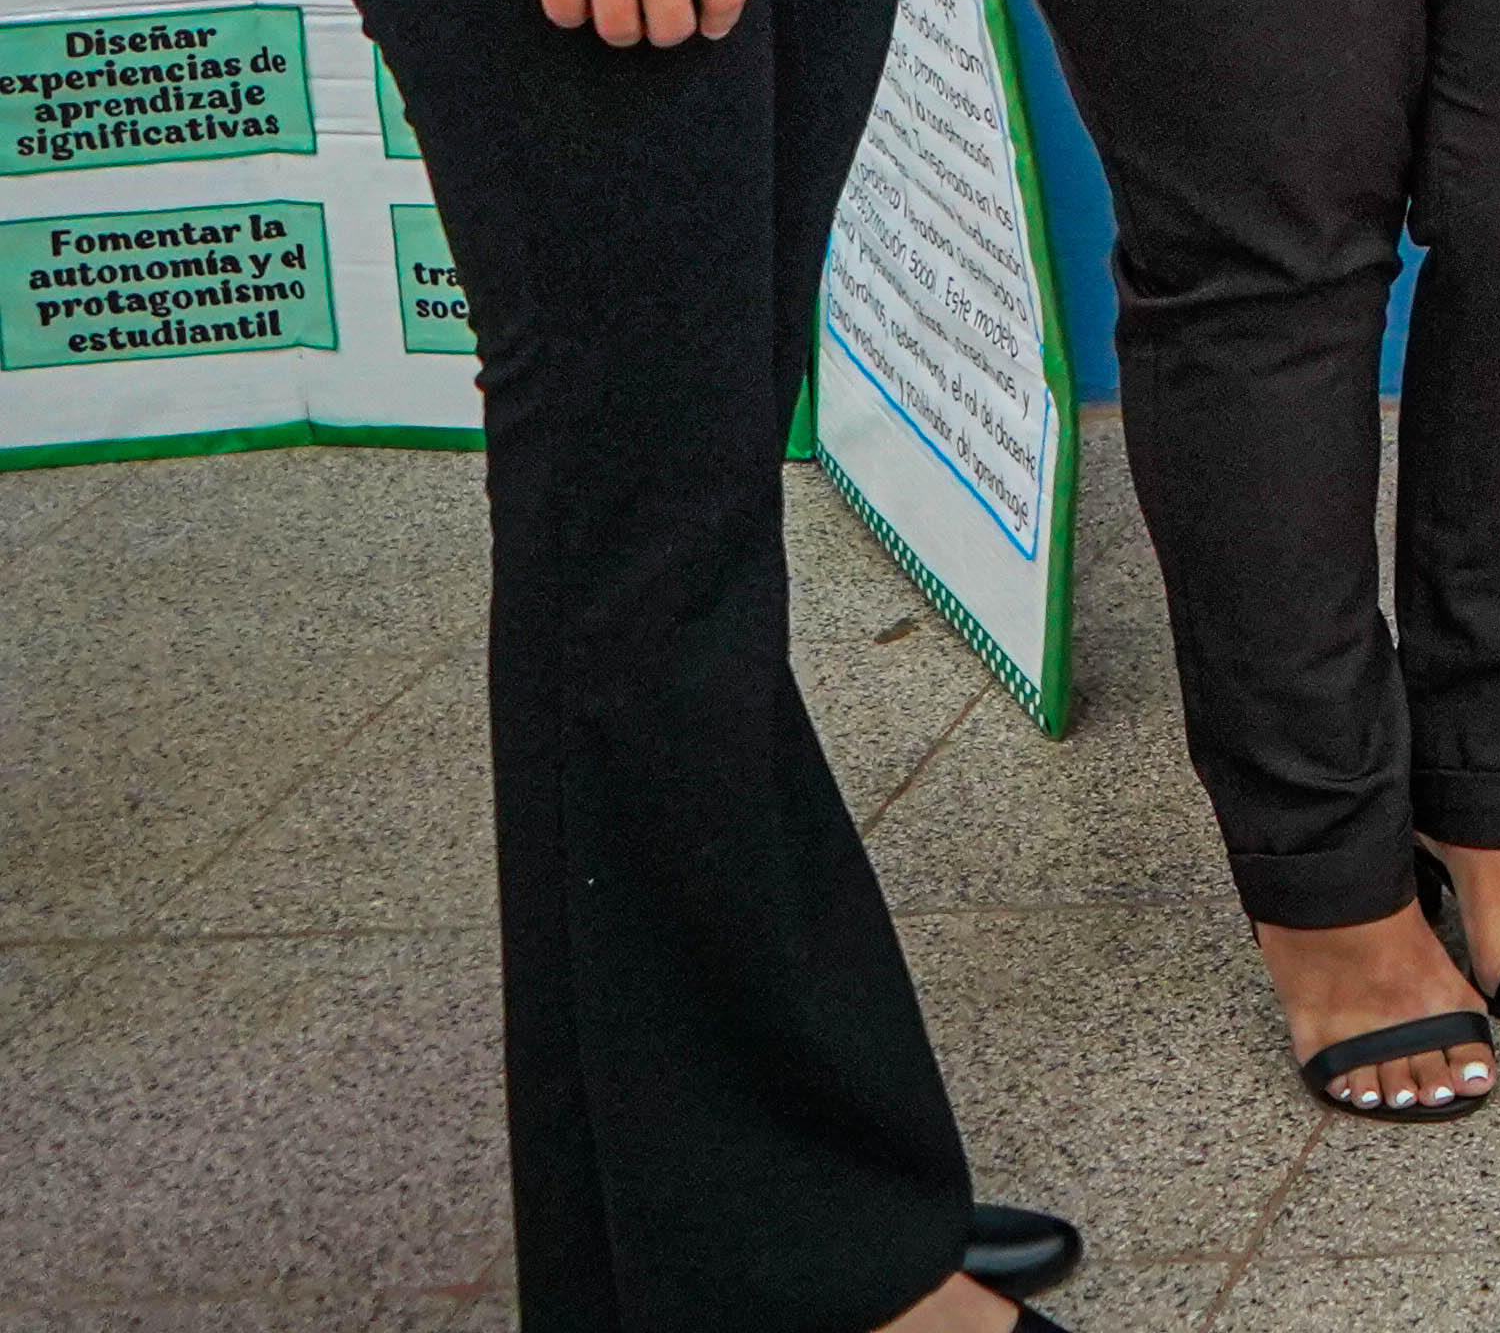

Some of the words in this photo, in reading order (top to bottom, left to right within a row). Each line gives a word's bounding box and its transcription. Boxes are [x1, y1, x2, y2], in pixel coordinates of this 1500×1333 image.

[66, 25, 216, 58] Diseñar
[0, 54, 241, 99] experiencias
[250, 46, 286, 73] de
[35, 81, 266, 127] aprendizaje
[17, 114, 280, 160] significativas
[52, 220, 241, 257] Fomentar
[249, 214, 288, 242] la
[29, 251, 243, 290] autonomía
[250, 252, 271, 279] y
[280, 244, 306, 270] el
[36, 279, 305, 326] protagonismo
[68, 309, 282, 353] estudiantil
